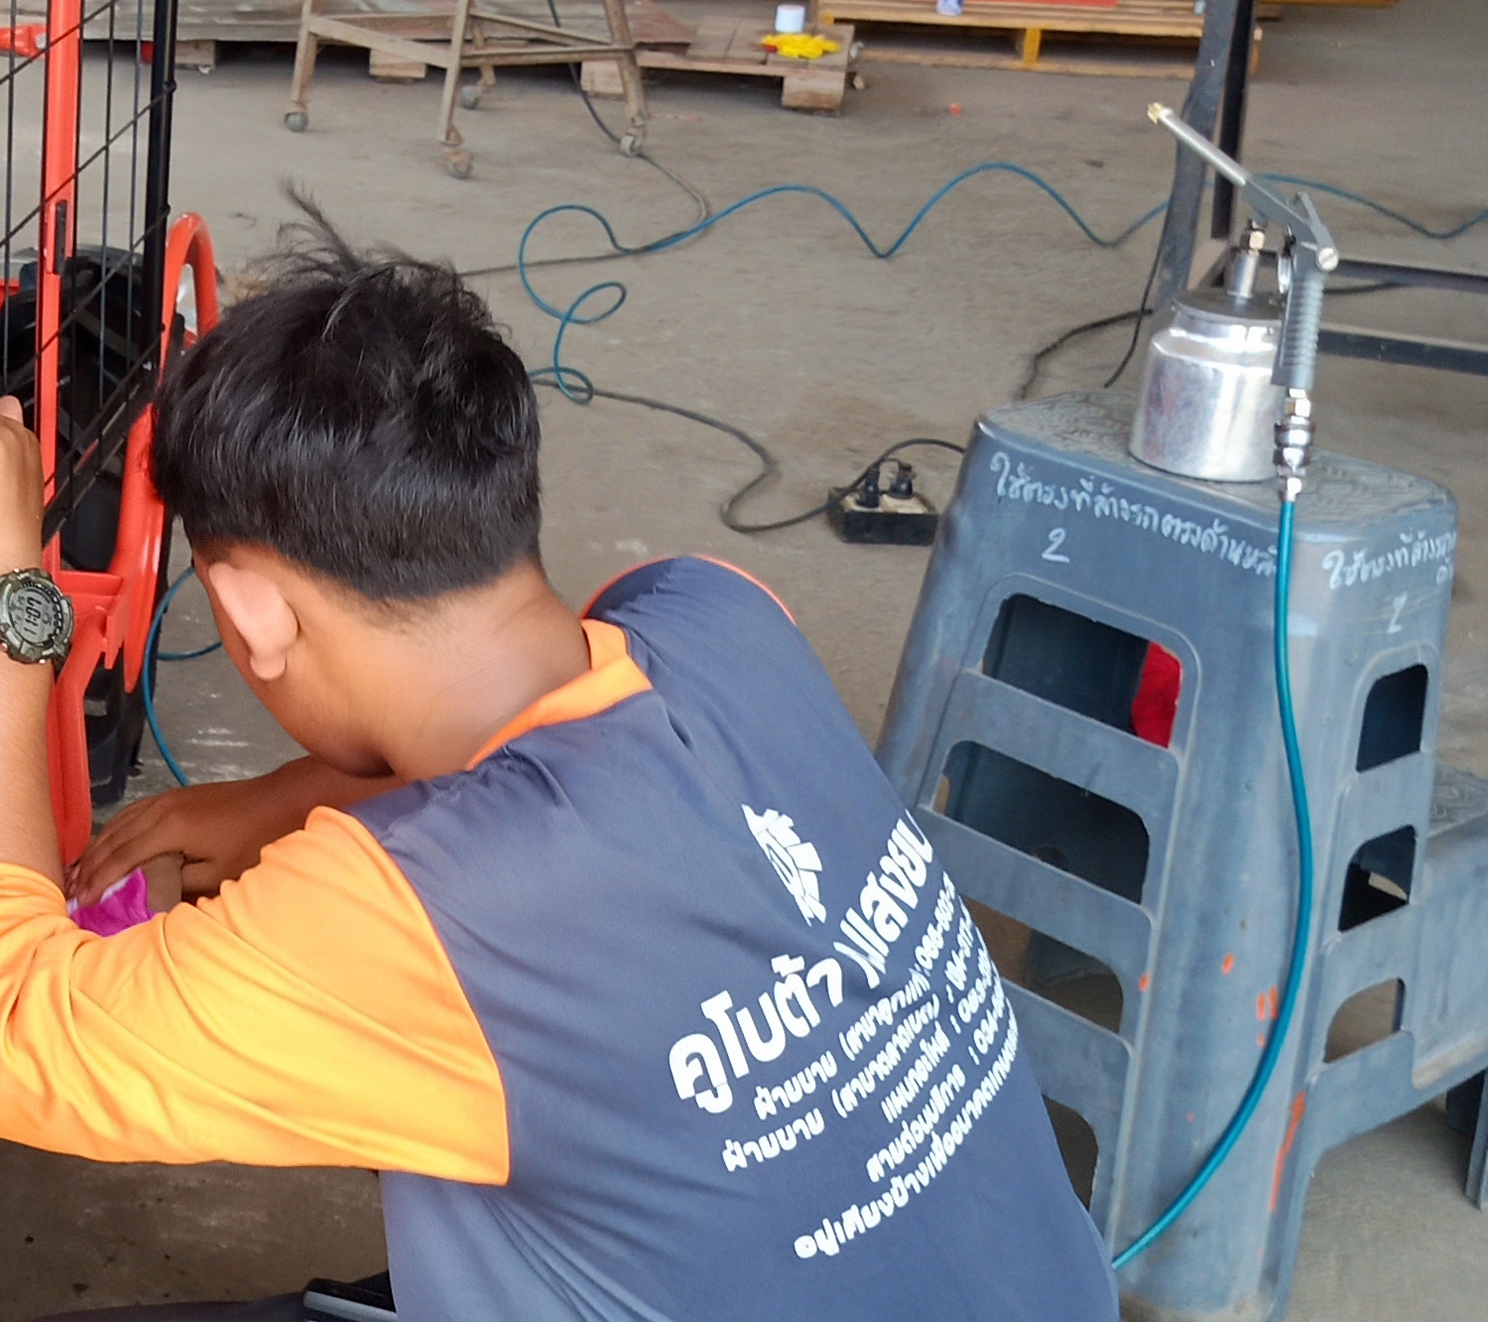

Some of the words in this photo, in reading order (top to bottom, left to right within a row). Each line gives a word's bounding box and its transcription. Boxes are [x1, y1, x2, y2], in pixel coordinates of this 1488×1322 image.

[1041, 527, 1071, 564] 2
[23, 596, 43, 636] 11:07
[669, 954, 843, 1114] คูโบต้า
[754, 1051, 838, 1120] ฝ่ายขาย
[722, 1108, 826, 1172] ฝ่ายขาย
